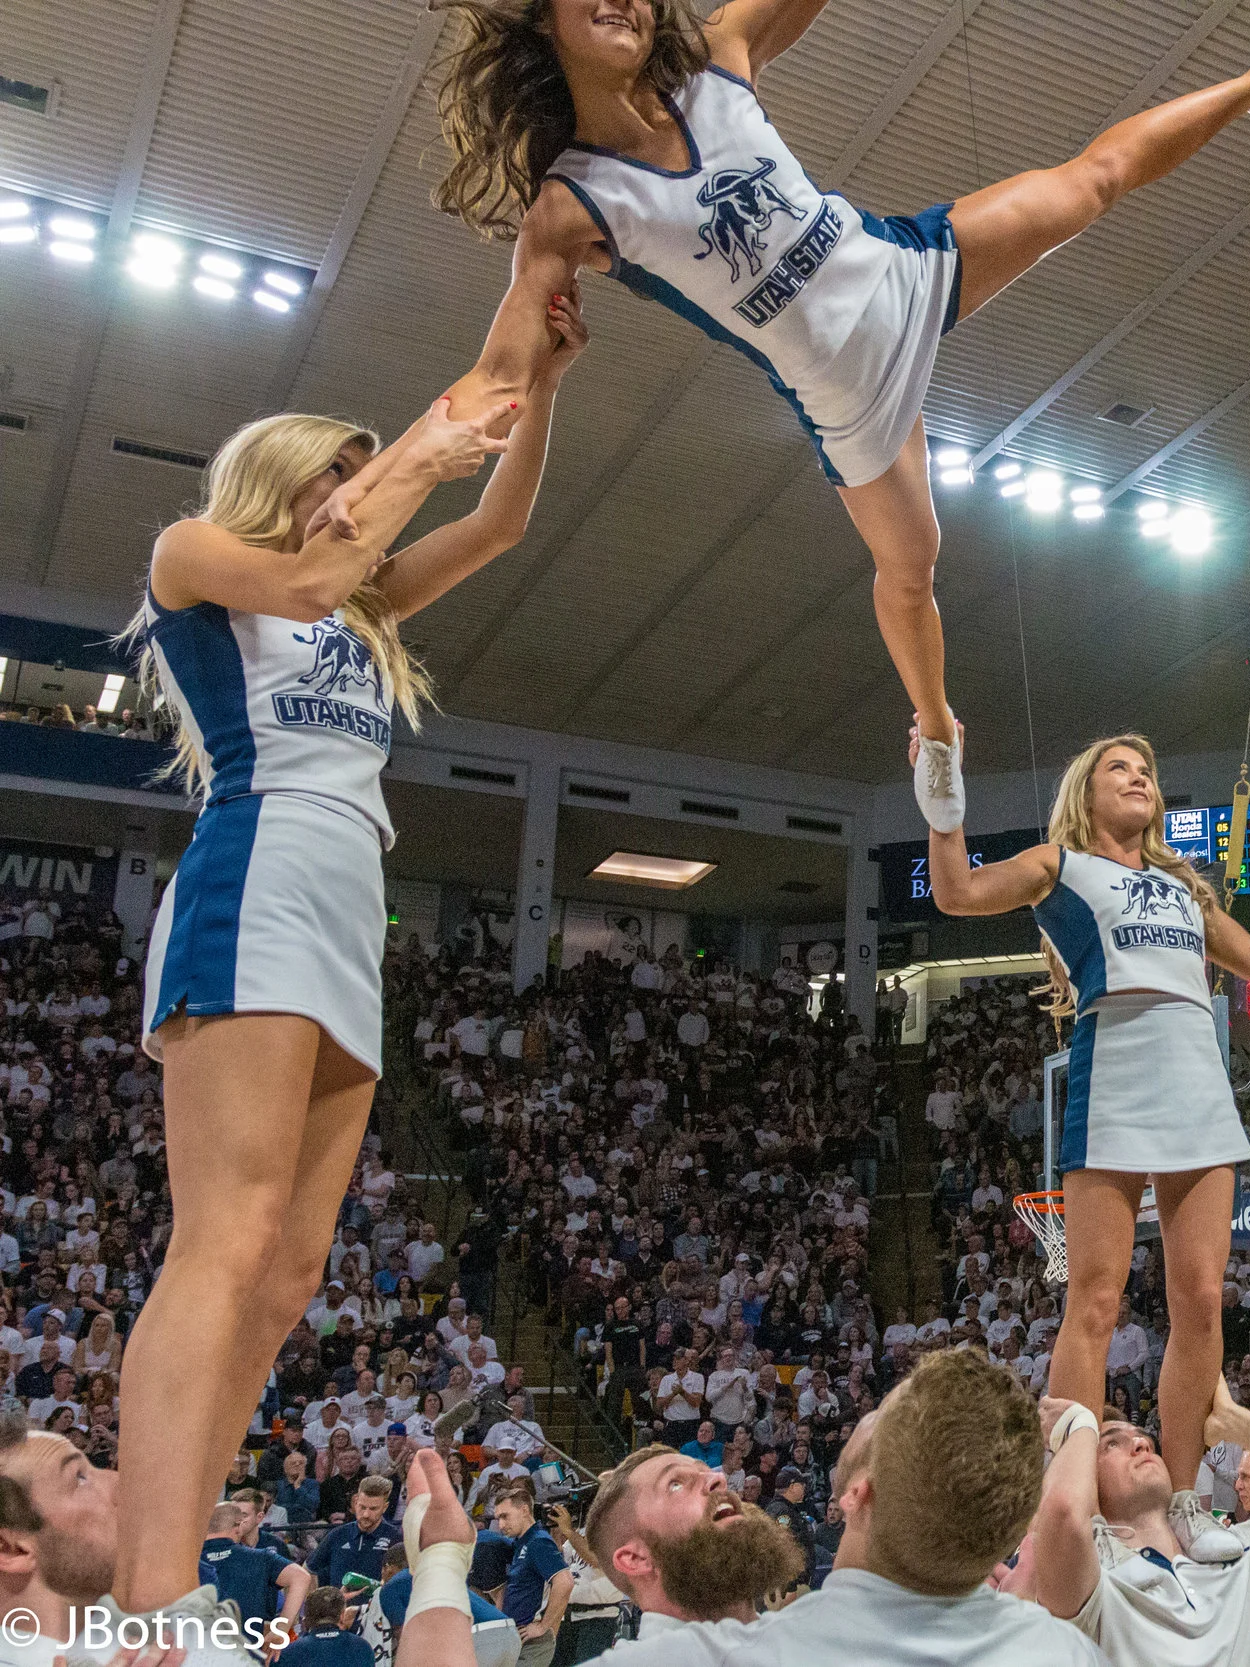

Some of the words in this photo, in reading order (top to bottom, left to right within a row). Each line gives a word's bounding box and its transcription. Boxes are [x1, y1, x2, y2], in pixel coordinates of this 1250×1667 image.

[732, 257, 806, 328] UTAH
[272, 694, 357, 736] UTAH
[1171, 811, 1203, 824] UTAH
[1171, 822, 1203, 833] Honda
[1171, 829, 1203, 839] dealers
[1218, 838, 1229, 847] 12
[1219, 852, 1229, 861] 15
[130, 858, 147, 875] B
[529, 904, 543, 921] C
[1111, 923, 1167, 950] UTAH
[859, 945, 870, 959] D
